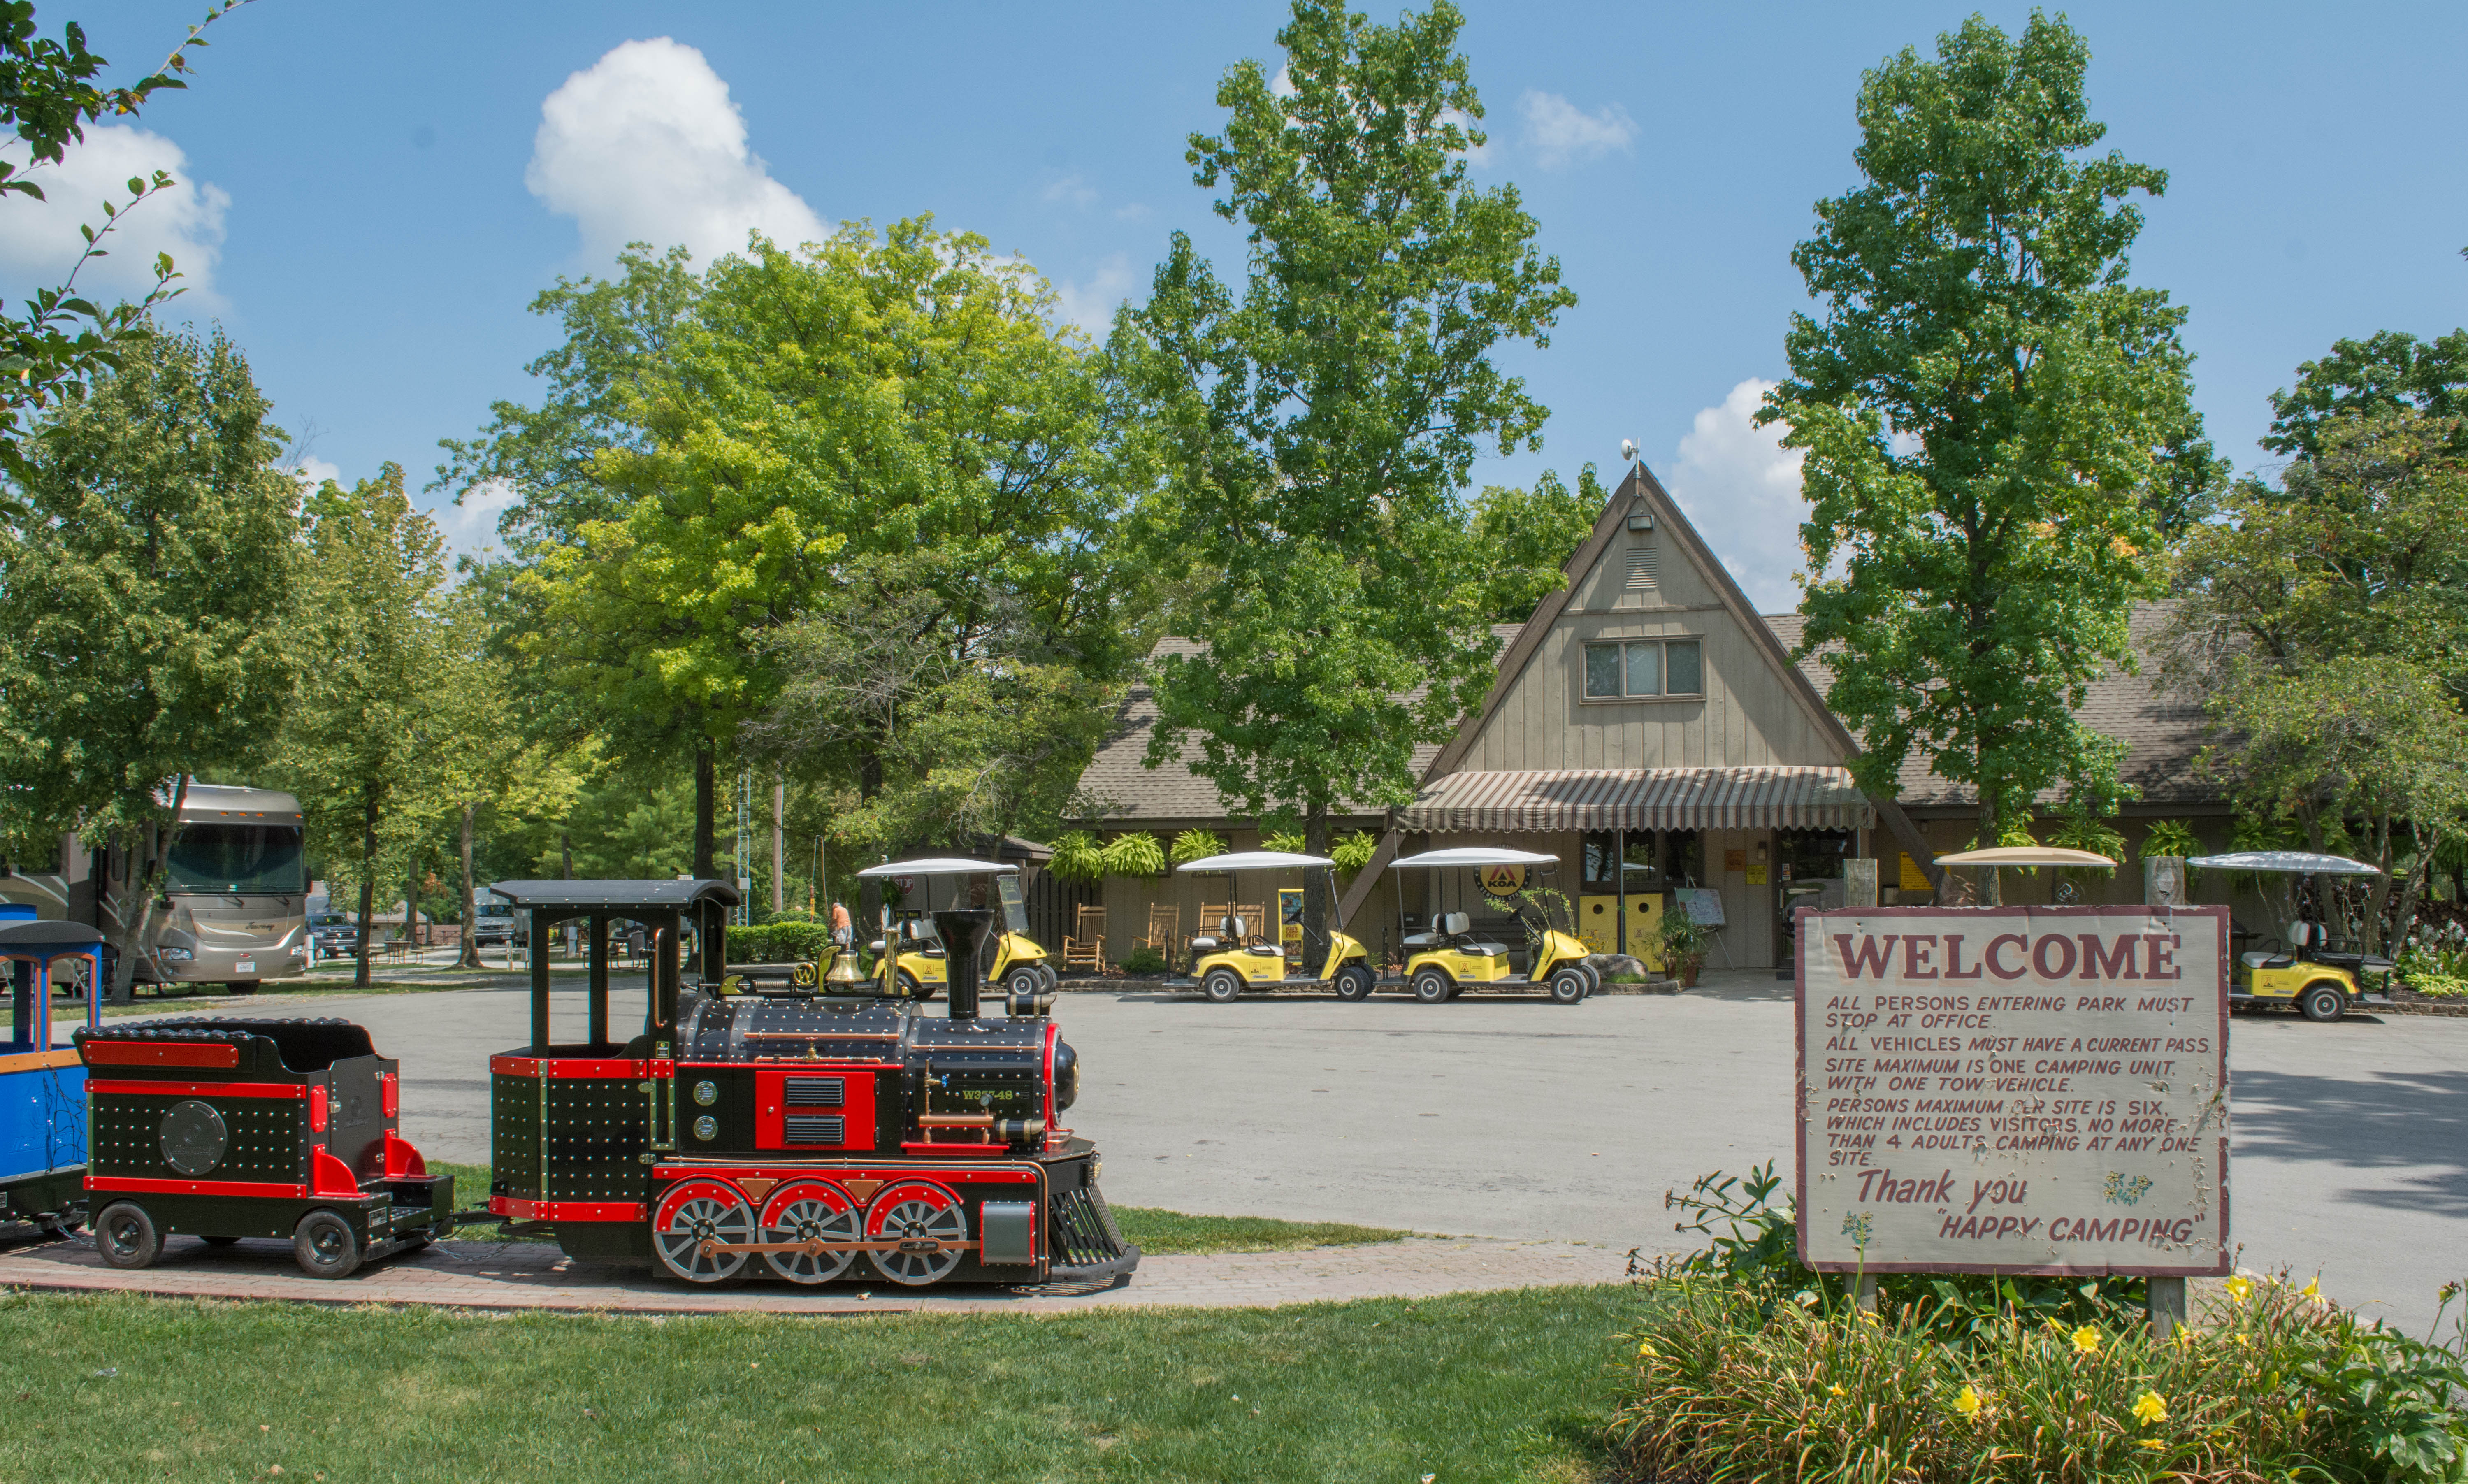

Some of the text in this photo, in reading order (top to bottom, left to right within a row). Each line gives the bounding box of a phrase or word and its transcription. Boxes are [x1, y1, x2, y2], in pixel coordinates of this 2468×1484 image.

[1833, 934, 2180, 980] WELCOME
[1827, 996, 2193, 1012] ALL PERSONS ENTERING PARK MUST
[1826, 1013, 1996, 1029] STOP AT OFFICE.
[1826, 1036, 2212, 1053] ALL VEHICLES MUST HAVE A CURRENT PASS.
[1825, 1058, 2175, 1076] SITE MAXIMUM IS ONE CAMPING UNIT,
[1828, 1076, 2074, 1092] WITH ONE TOW VEHICLE.
[1827, 1098, 1908, 1112] PERSONS
[1915, 1099, 2003, 1113] MAXIMUM
[2052, 1100, 2091, 1114] SITE
[2098, 1100, 2115, 1115] IS
[2128, 1100, 2168, 1116] SIX,
[1827, 1116, 1888, 1130] WHICH
[1892, 1116, 1980, 1131] INCLUDES
[2088, 1118, 2113, 1132] NO
[2120, 1118, 2178, 1133] MORE
[1827, 1133, 1875, 1147] THAN
[1886, 1134, 1900, 1148] 4
[1996, 1135, 2078, 1150] CAMPING
[2086, 1136, 2112, 1151] AT
[2115, 1136, 2153, 1151] ANY
[2161, 1136, 2200, 1151] ONE
[1829, 1152, 1876, 1166] SITE.
[1857, 1168, 2027, 1214] Thank you
